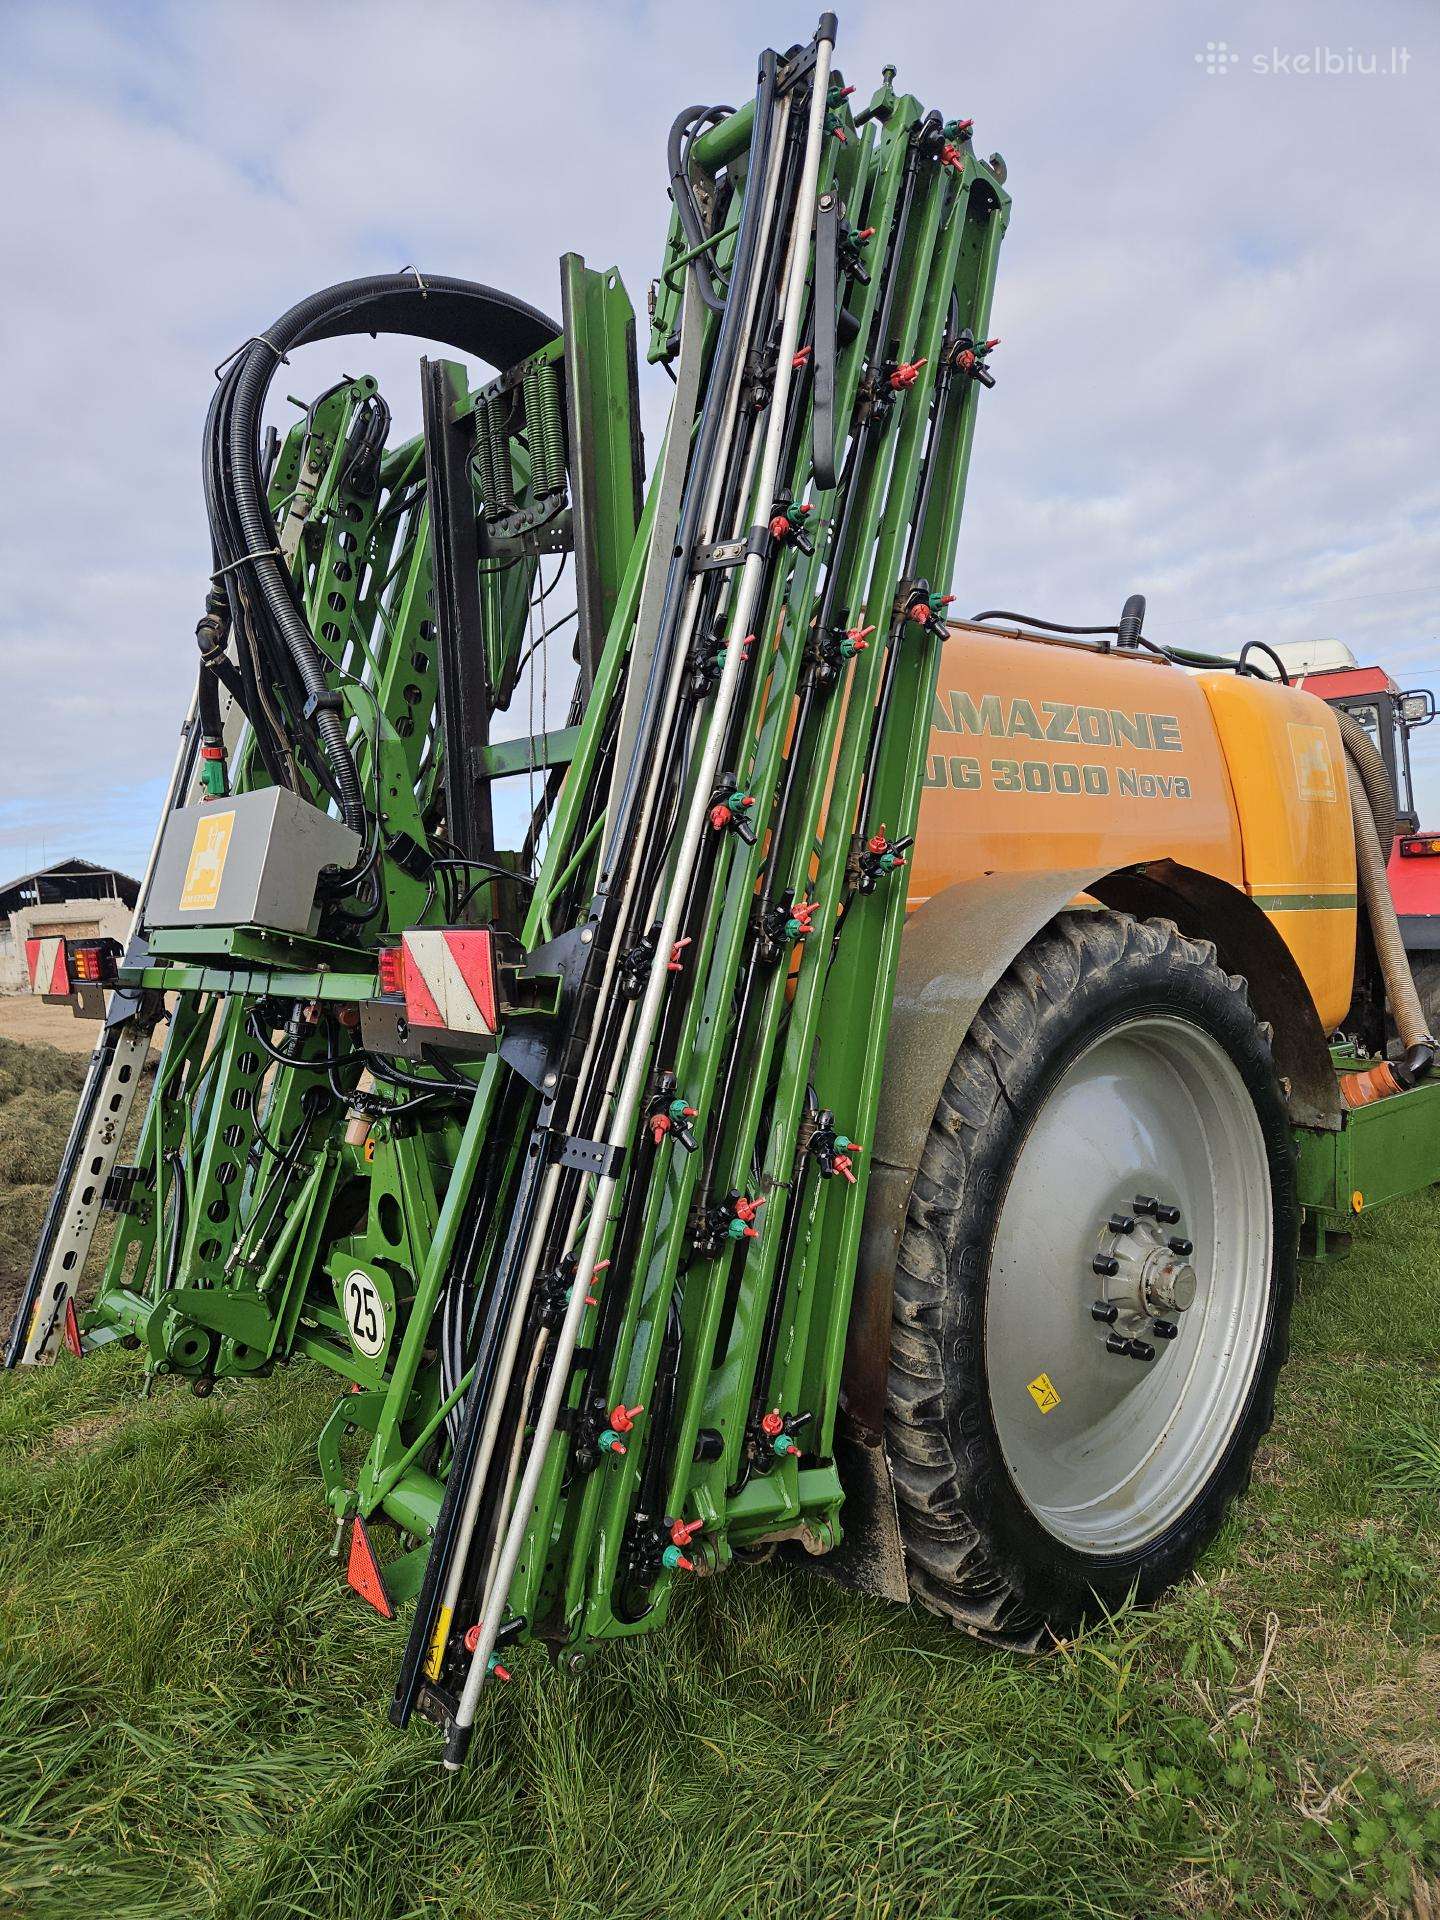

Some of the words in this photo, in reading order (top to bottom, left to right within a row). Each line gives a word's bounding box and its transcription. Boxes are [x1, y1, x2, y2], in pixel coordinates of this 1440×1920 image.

[991, 759, 1110, 796] 3000
[1116, 766, 1192, 799] Nova
[350, 1283, 378, 1342] 25
